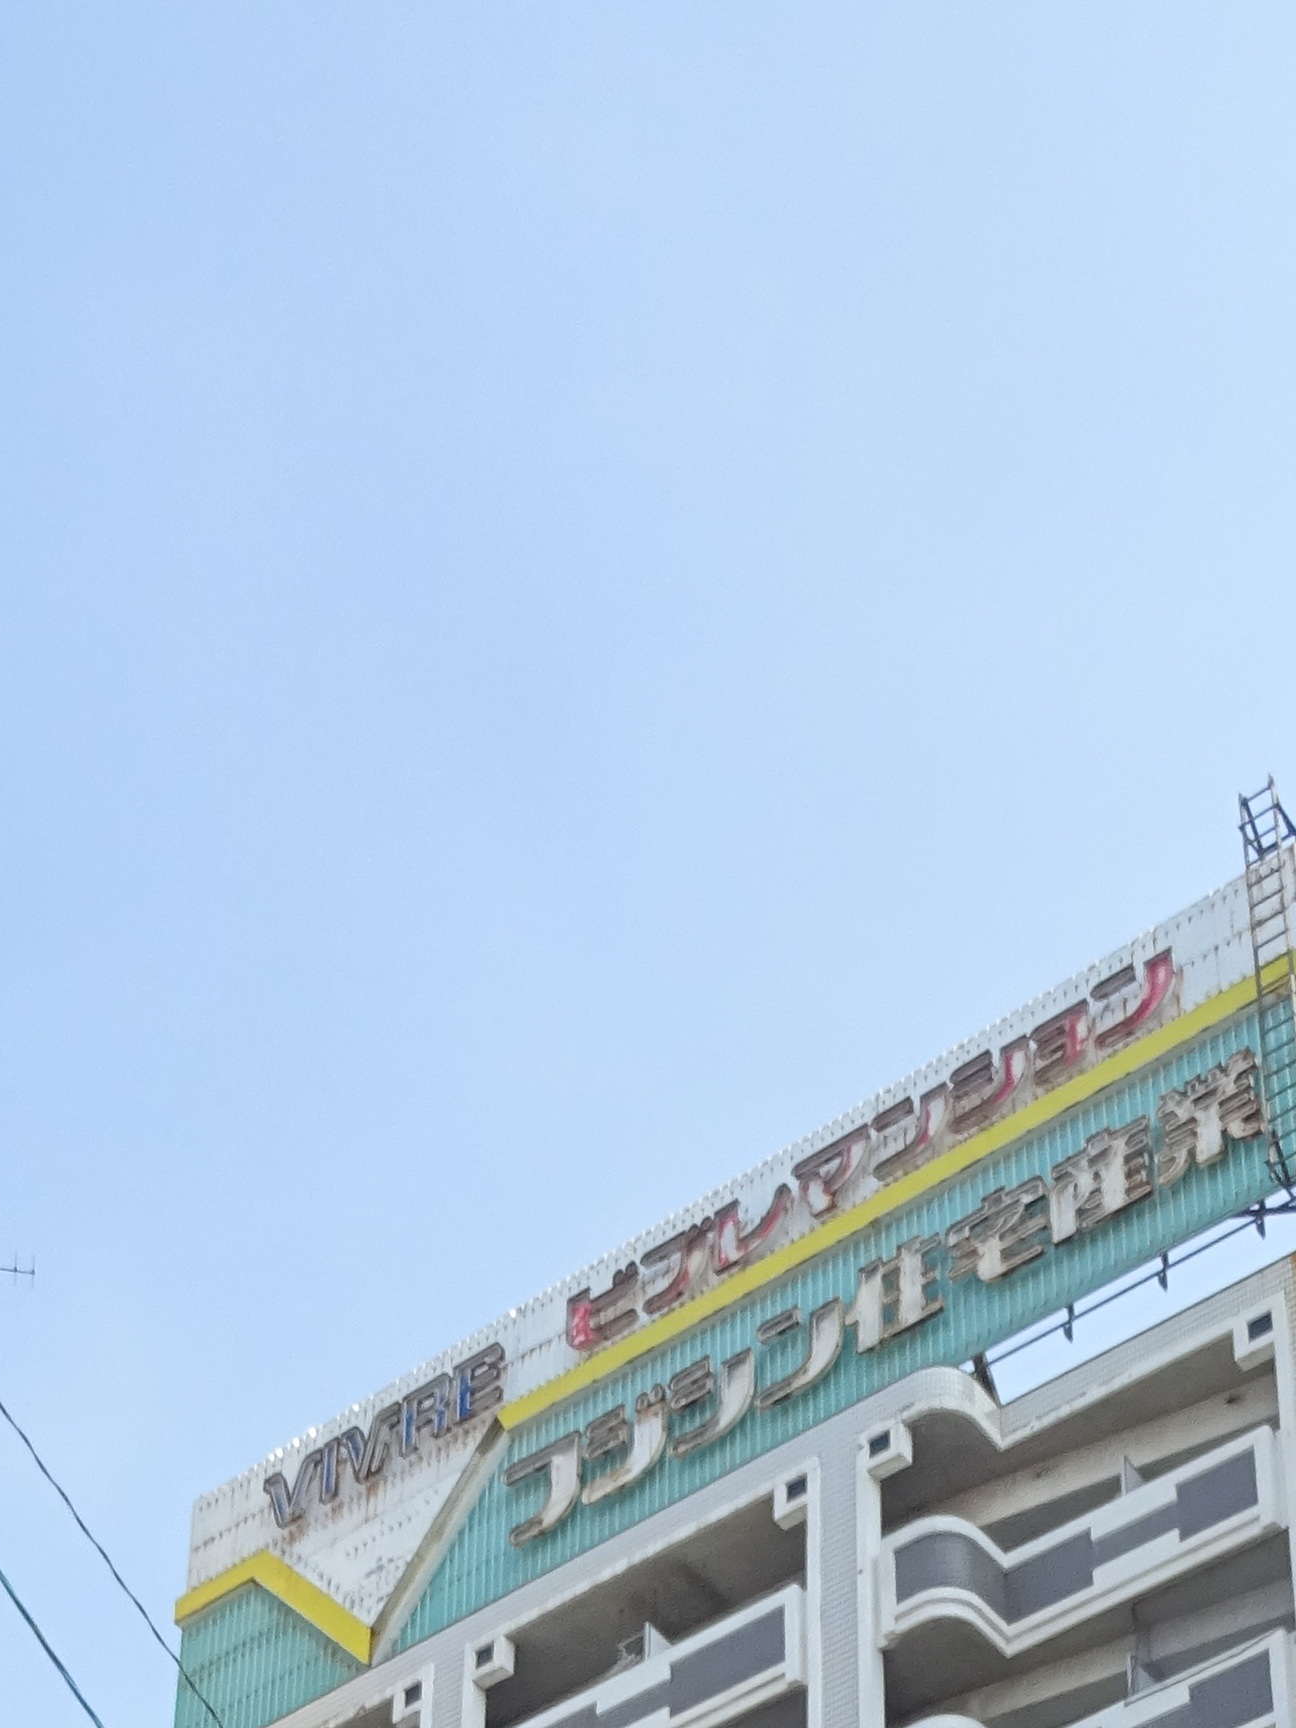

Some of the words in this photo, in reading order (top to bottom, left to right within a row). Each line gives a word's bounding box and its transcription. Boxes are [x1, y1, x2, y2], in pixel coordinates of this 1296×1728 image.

[263, 1341, 506, 1530] VIVRE
[565, 947, 1184, 1351] ビブレマンション
[504, 1048, 1268, 1549] フジシン住宅産業
